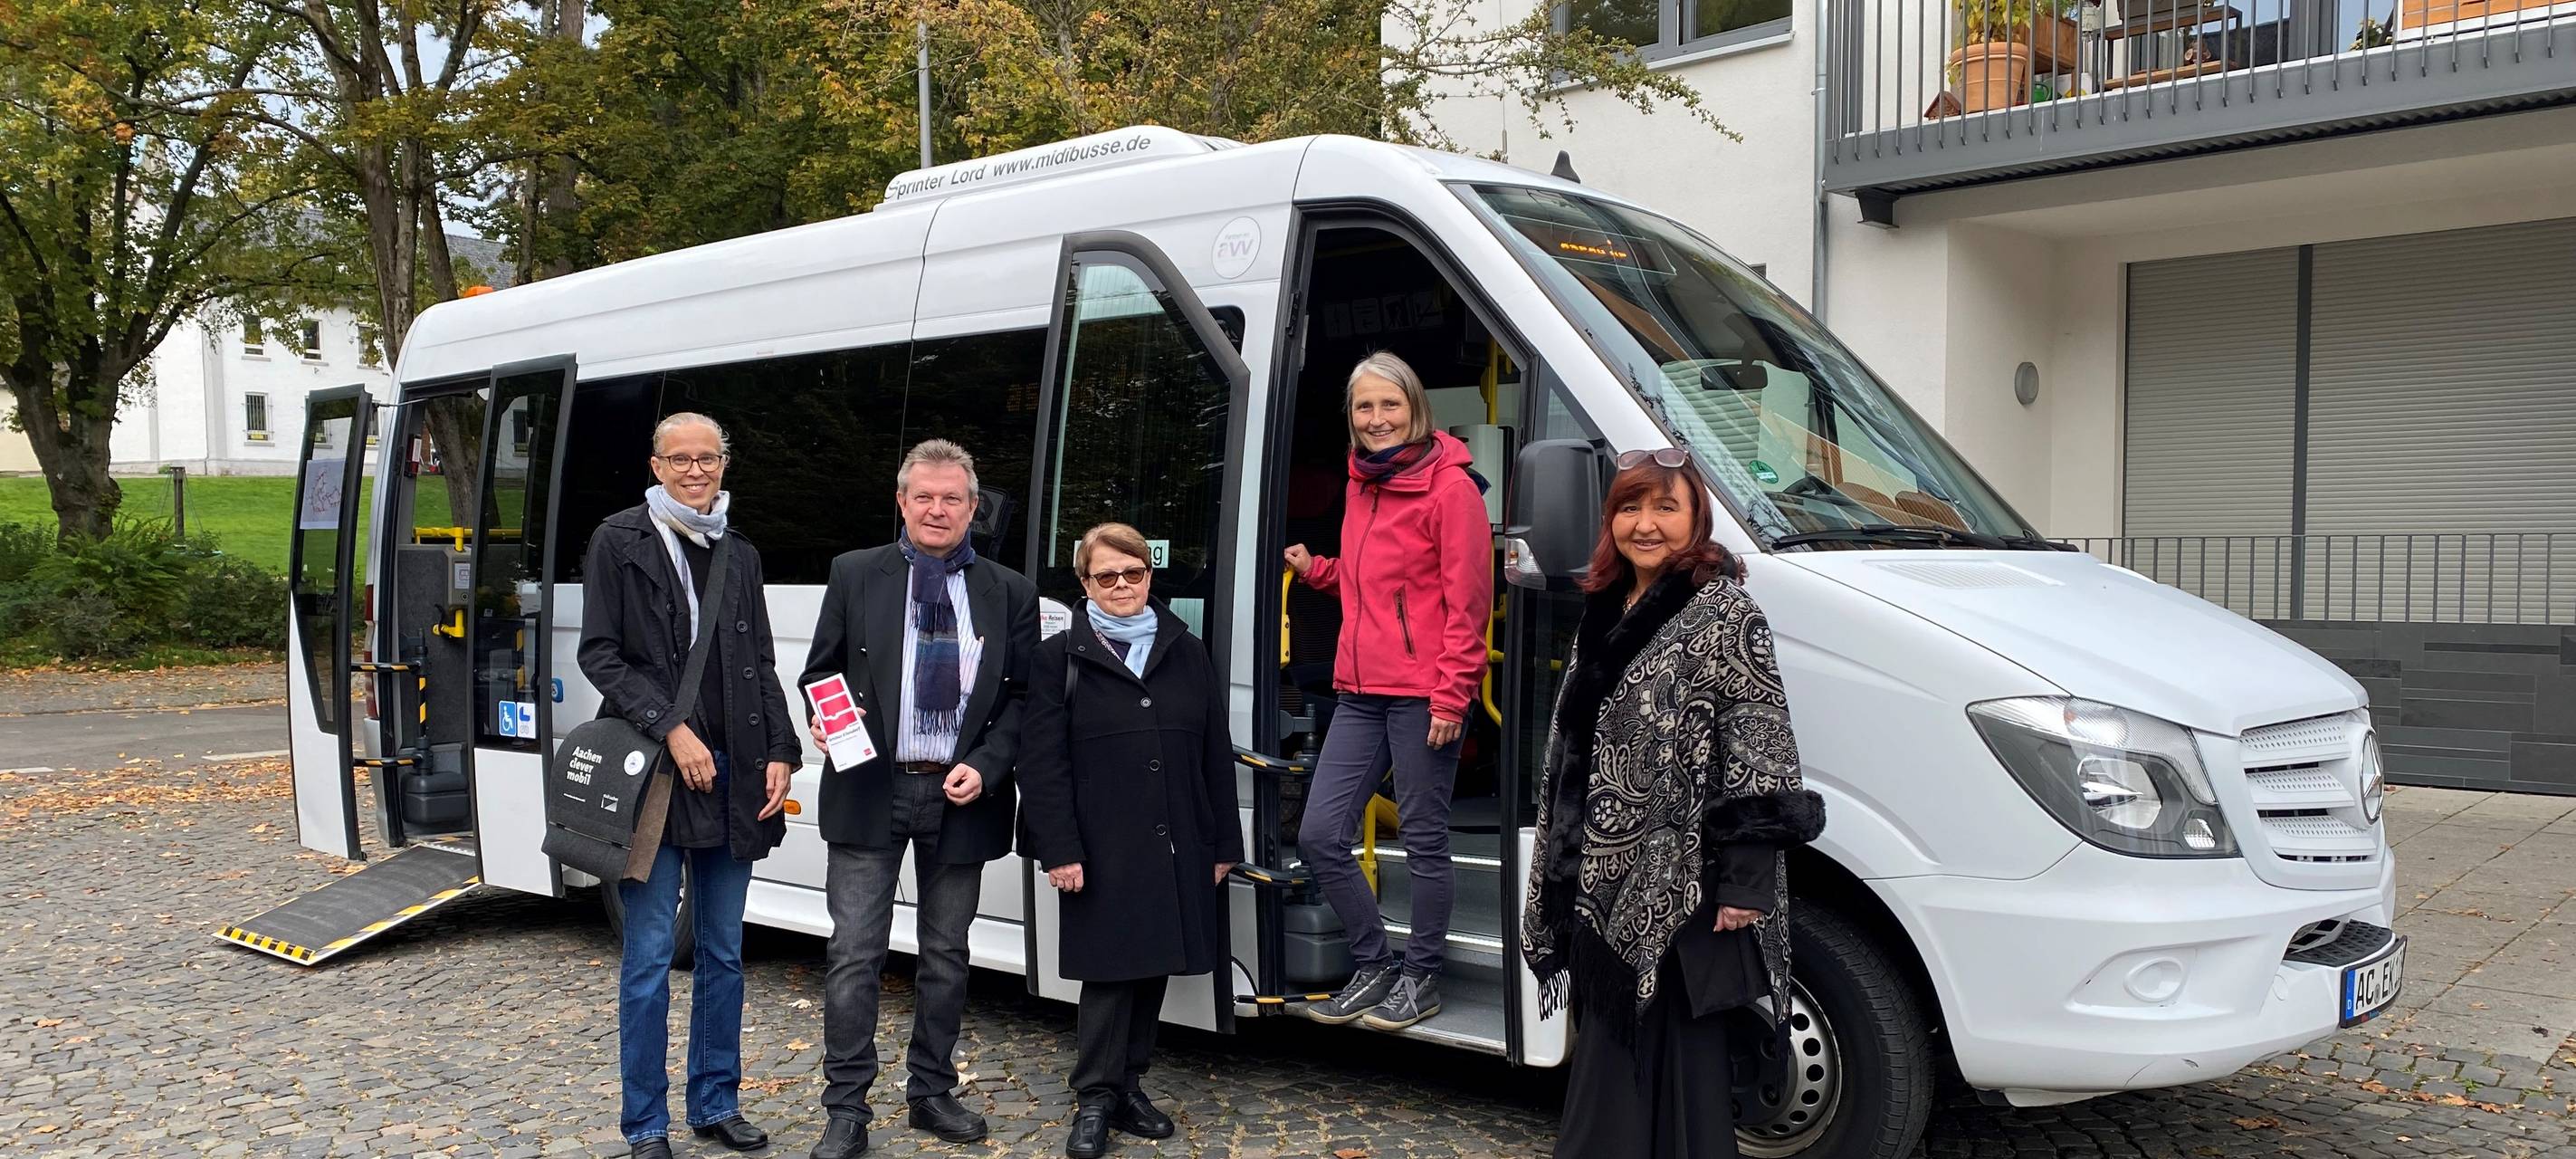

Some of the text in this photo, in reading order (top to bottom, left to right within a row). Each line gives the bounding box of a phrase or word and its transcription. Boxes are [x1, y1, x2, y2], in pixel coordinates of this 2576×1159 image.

[950, 164, 987, 186] Lord
[994, 135, 1150, 177] www.midibusse.de
[572, 745, 603, 764] Aachen
[569, 757, 594, 773] clever
[567, 771, 591, 786] mobil
[2356, 968, 2375, 1010] AC
